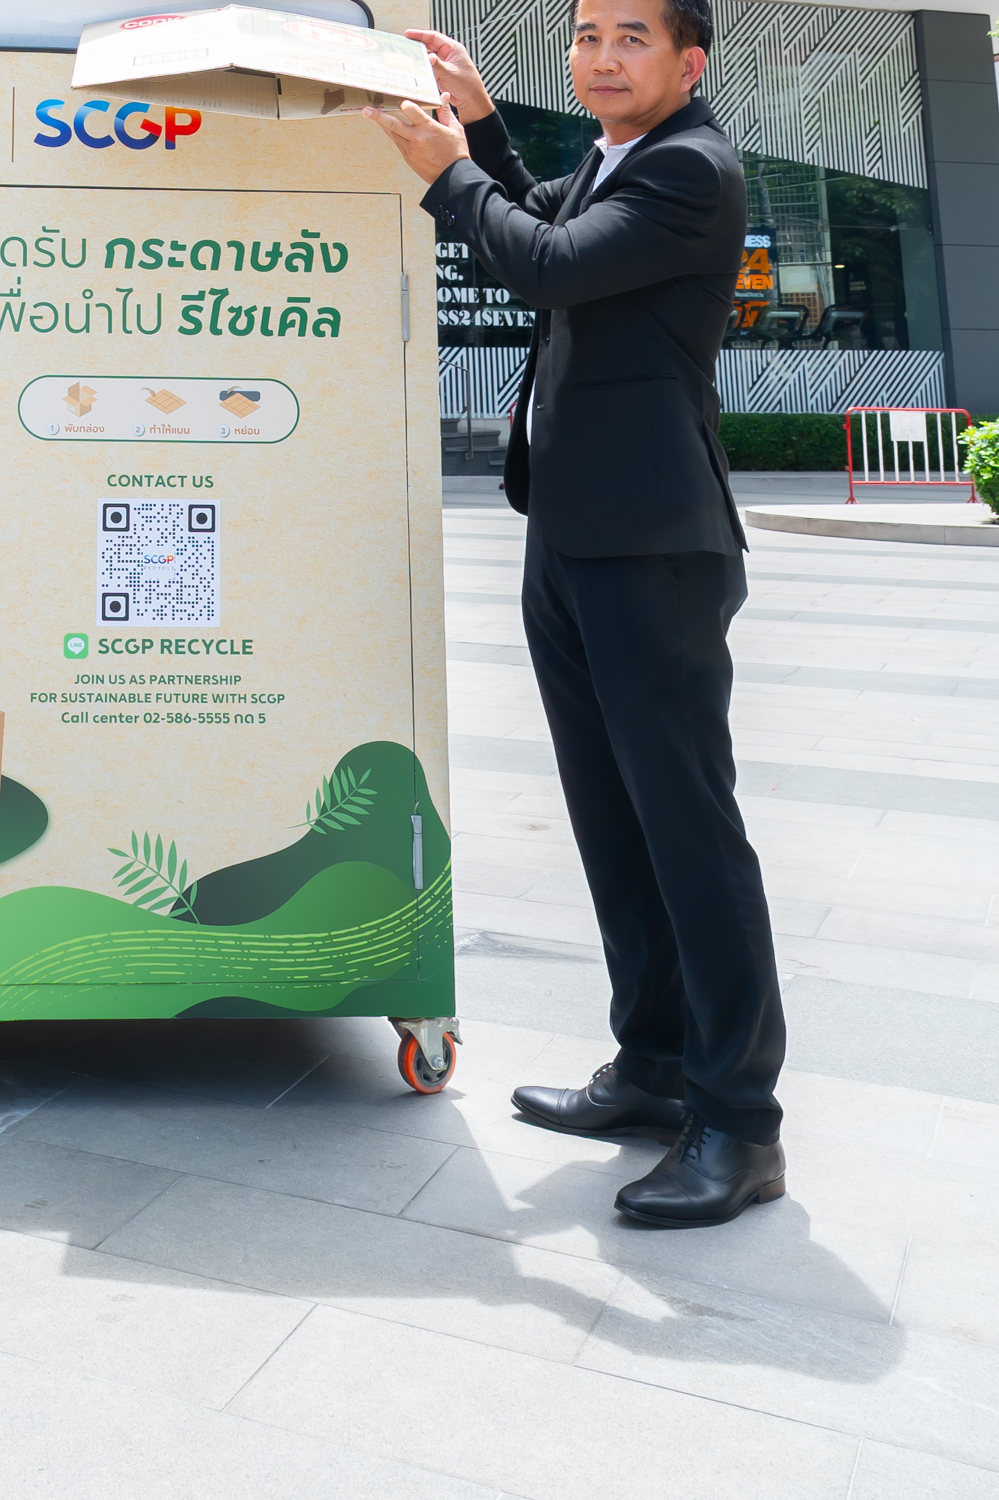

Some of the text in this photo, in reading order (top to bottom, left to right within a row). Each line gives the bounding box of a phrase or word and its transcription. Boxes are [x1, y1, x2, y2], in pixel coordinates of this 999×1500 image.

[34, 98, 202, 150] SCGP
[104, 229, 349, 274] กระดาษลัง
[435, 242, 469, 258] GET
[482, 288, 510, 304] TO
[177, 288, 342, 338] รีไซเคิล
[64, 423, 106, 435] พับกล่อง
[149, 423, 191, 436] ทำให้แบน
[234, 426, 261, 436] หย่อน
[107, 474, 214, 488] CONTACT US
[144, 554, 175, 564] SCGP
[98, 638, 154, 655] SCGP
[160, 638, 254, 655] RECYCLE
[74, 674, 242, 686] JOIN US AS PARTNERSHIP
[30, 692, 286, 704] FOR SUSTAINABLE FUTURE WITH SCGP
[61, 711, 266, 724] Call center 02-586-5555 กด 5
